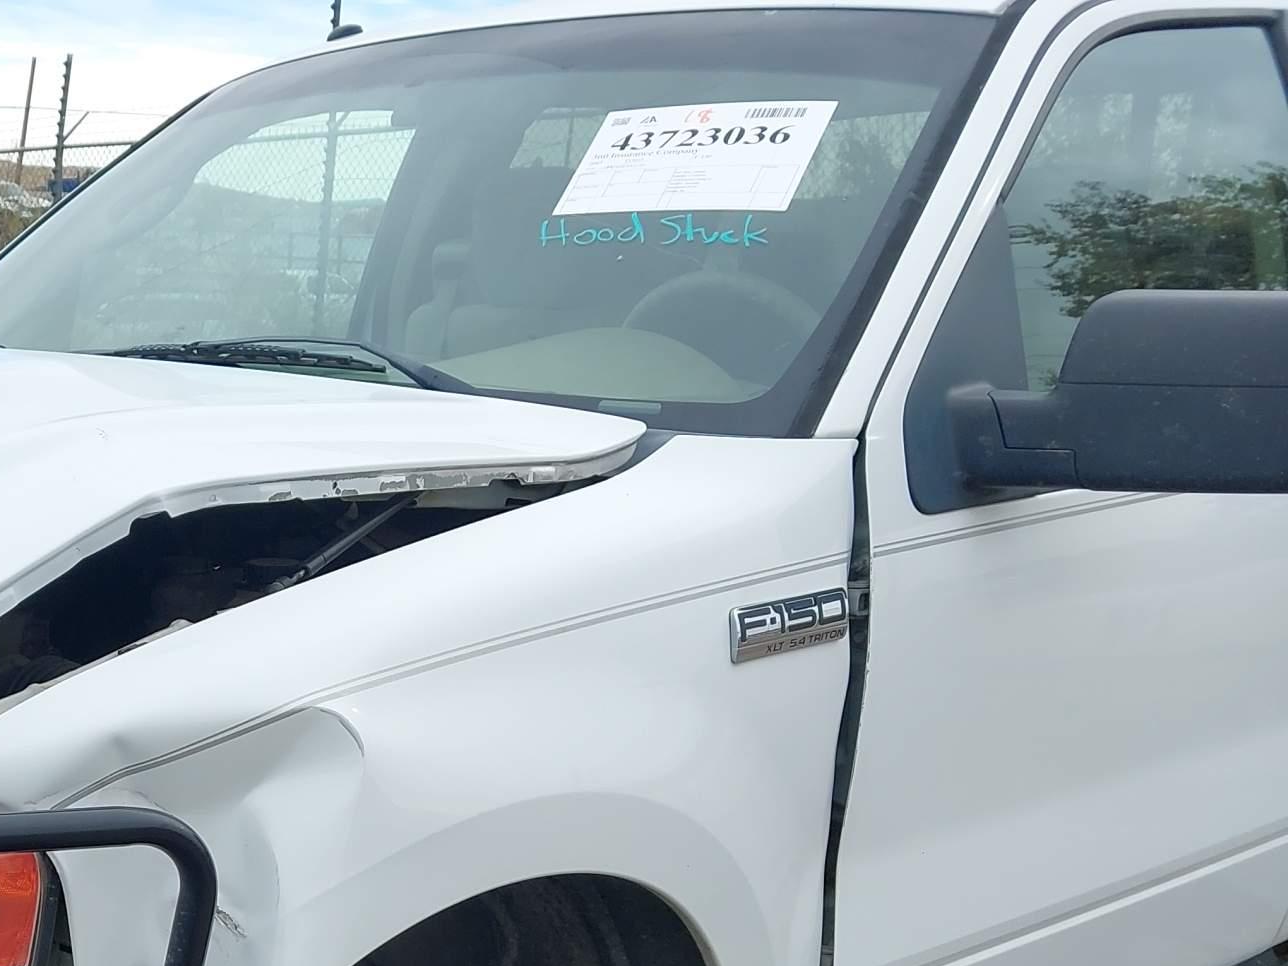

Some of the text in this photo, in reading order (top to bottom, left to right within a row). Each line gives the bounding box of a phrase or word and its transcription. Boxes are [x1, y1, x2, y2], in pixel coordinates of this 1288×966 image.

[611, 125, 794, 151] 43723036
[538, 211, 768, 247] Hood Stuck
[737, 591, 847, 643] F-150
[766, 641, 785, 654] XLT
[808, 629, 845, 642] TRITON
